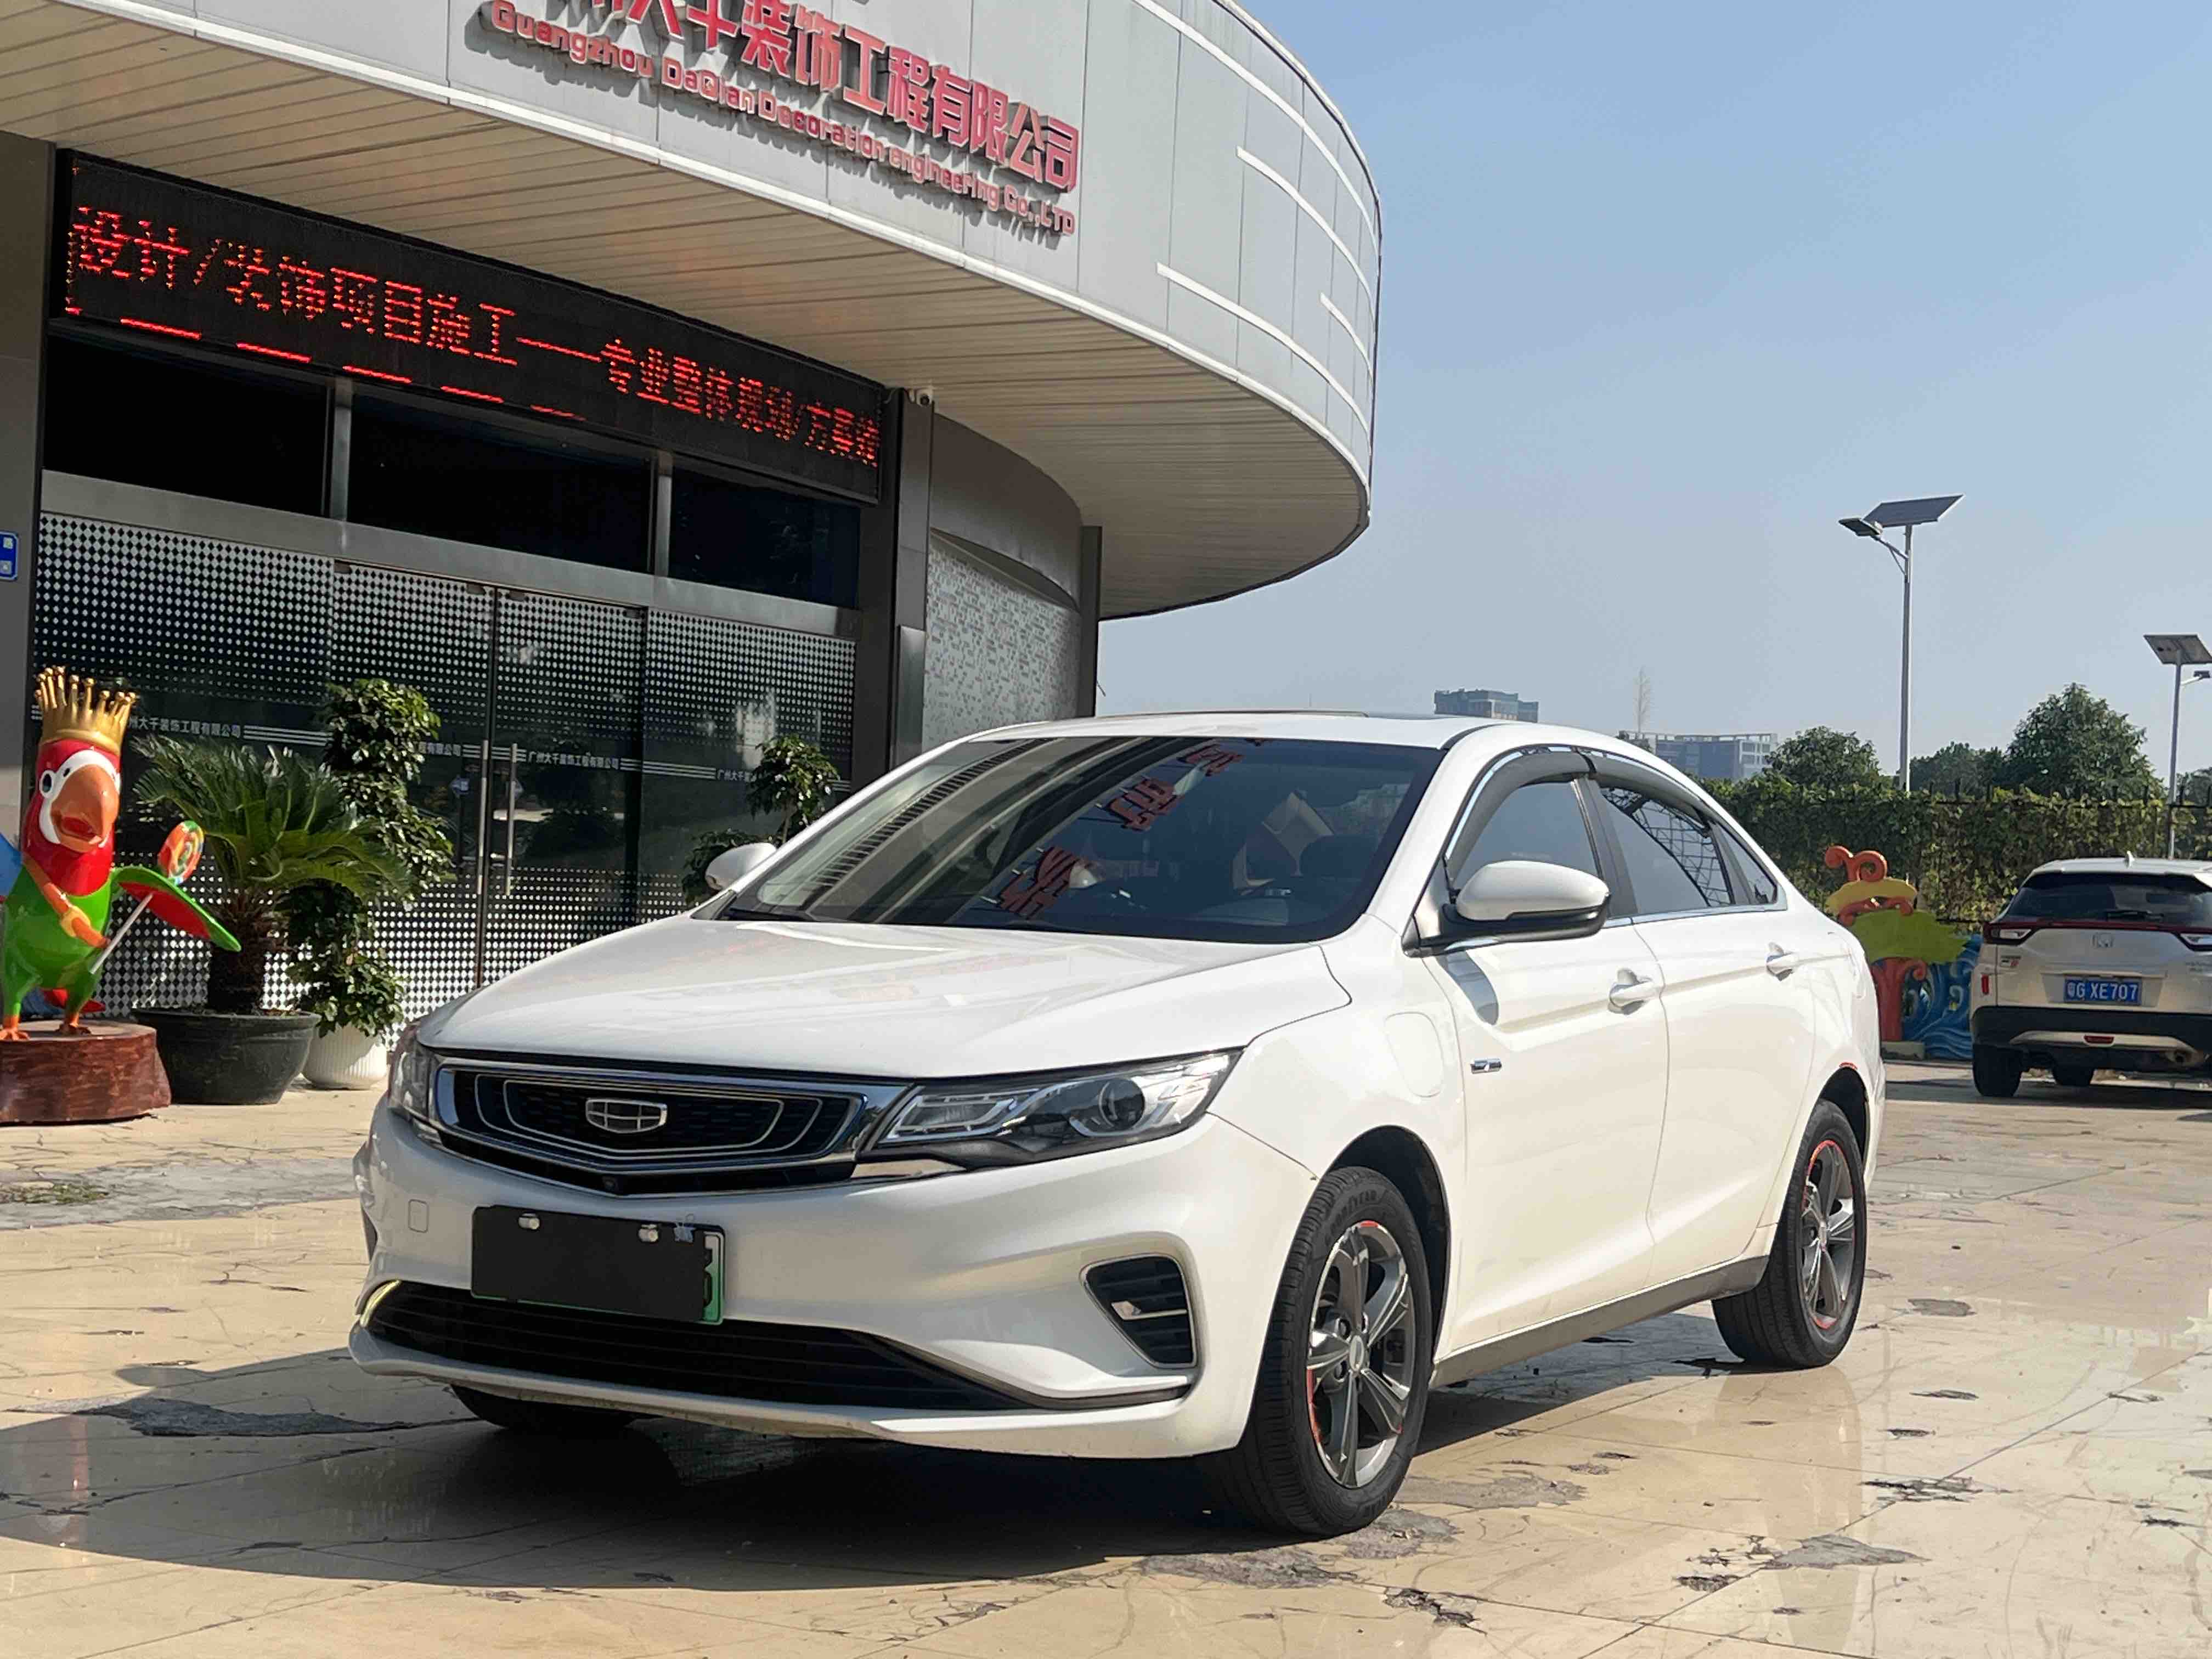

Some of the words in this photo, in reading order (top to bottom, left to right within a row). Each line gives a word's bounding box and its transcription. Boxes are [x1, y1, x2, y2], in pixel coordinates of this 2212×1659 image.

[492, 0, 654, 78] Guangzhou
[662, 57, 755, 114] DaQian
[758, 90, 884, 162] Decoration
[889, 145, 1000, 212] engineering
